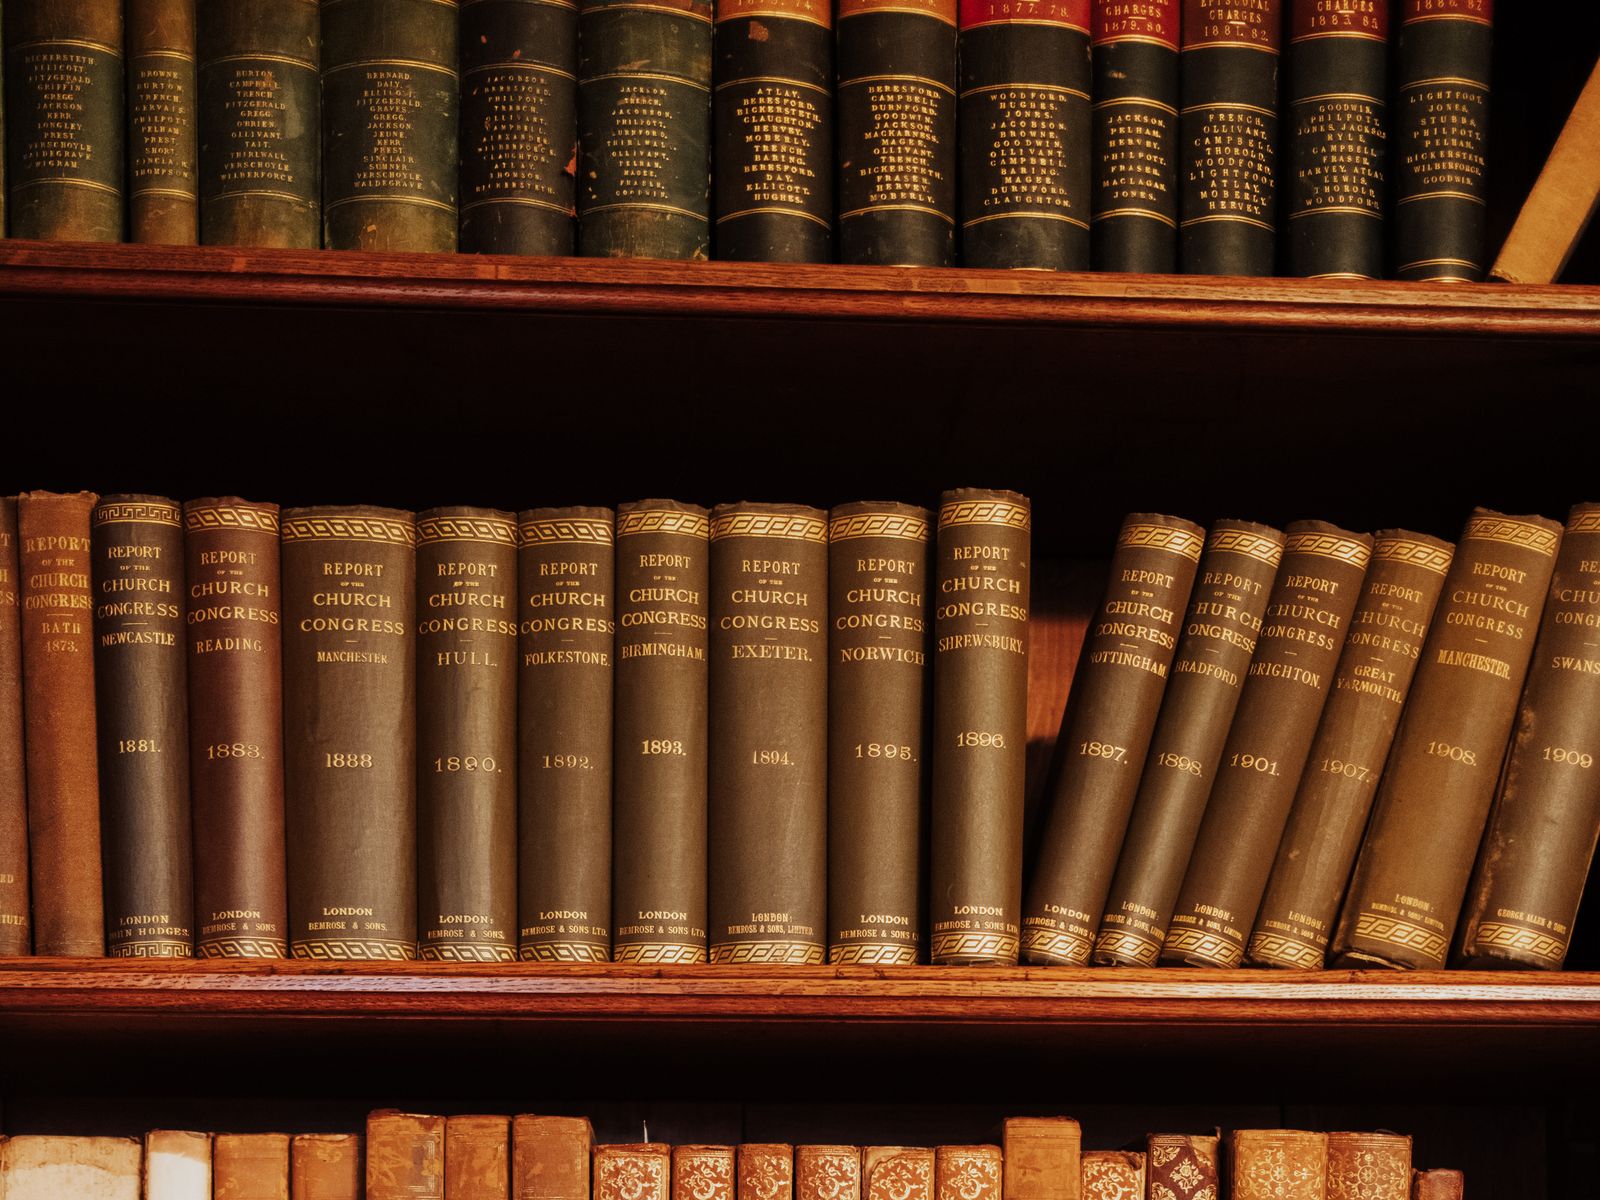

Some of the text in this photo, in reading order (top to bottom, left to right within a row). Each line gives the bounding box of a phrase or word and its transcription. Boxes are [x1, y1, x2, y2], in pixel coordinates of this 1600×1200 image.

[989, 3, 1038, 15] 1877.
[1105, 5, 1162, 17] CHARGES
[1317, 0, 1374, 13] CHARGES
[1209, 10, 1262, 23] CHARGES
[757, 88, 800, 99] ATLAY.
[868, 86, 941, 99] BERESFORD.
[990, 92, 1067, 102] WOODFORD.
[1411, 91, 1482, 104] LIGHTFOOT.
[743, 98, 815, 110] BERESFORD.
[871, 95, 937, 108] CAMPBELL.
[1000, 102, 1058, 110] HUGHES.
[737, 106, 821, 122] BICKERSTETH.
[871, 105, 937, 116] DURNFORD.
[1005, 110, 1052, 119] JONES.
[743, 115, 814, 129] CLAUGHTON.
[874, 113, 933, 124] GOODWIN.
[990, 121, 1066, 130] JACOBSON.
[1108, 115, 1166, 128] JACKSON.
[754, 125, 803, 136] HERVEY.
[864, 130, 939, 144] MACKARNESS.
[1000, 131, 1058, 139] BROWNE.
[746, 135, 810, 147] MOBERLY.
[994, 140, 1062, 149] GOODWIN.
[1426, 139, 1474, 150] PELHAM.
[754, 145, 806, 156] TRENCH.
[873, 147, 934, 158] OLLIVANT.
[1206, 147, 1266, 162] THOROLD.
[1312, 145, 1376, 158] CAMPBELL.
[755, 155, 806, 165] BARING.
[1104, 152, 1166, 166] PHILPOTT.
[1196, 158, 1272, 175] WOODFORD.
[860, 166, 943, 180] BICKERSTETH.
[746, 183, 810, 194] ELLICOTT.
[1103, 178, 1166, 192] MACLAGAN.
[1324, 176, 1367, 186] LEWIS.
[992, 186, 1068, 195] DURNFORD.
[1113, 190, 1156, 200] JONES.
[754, 194, 804, 204] HUGHES.
[984, 197, 1071, 208] CLAUGHTON.
[26, 536, 90, 553] REPORT
[108, 546, 162, 559] REPORT
[201, 550, 256, 566] REPORT
[954, 546, 1010, 560] REPORT
[640, 554, 690, 568] REPORT
[742, 560, 800, 574] REPORT
[857, 558, 914, 574] REPORT
[324, 562, 384, 577] REPORT
[438, 564, 498, 578] REPORT
[540, 562, 598, 576] REPORT
[1473, 562, 1526, 584] REPORT
[30, 573, 88, 588] CHURCH
[103, 578, 170, 593] CHURCH
[942, 576, 1020, 594] CHURCH
[1122, 569, 1174, 588] REPORT
[1204, 572, 1262, 596] REPORT
[1286, 576, 1338, 594] REPORT
[192, 582, 268, 598] CHURCH
[630, 588, 698, 604] CHURCH
[847, 589, 920, 606] CHURCH
[1370, 582, 1423, 604] REPORT
[313, 593, 392, 608] CHURCH
[429, 593, 504, 608] CHURCH
[530, 592, 606, 608] CHURCH
[732, 590, 808, 606] CHURCH
[1452, 591, 1530, 618] CHURCH
[98, 602, 178, 620] CONGRESS
[188, 606, 278, 624] CONGRESS
[936, 602, 1026, 622] CONGRESS
[1106, 600, 1174, 624] CHURCH
[42, 622, 80, 634] BATH
[301, 618, 404, 636] CONGRESS
[419, 618, 517, 636] CONGRESS
[521, 618, 615, 634] CONGRESS
[622, 611, 706, 630] CONGRESS
[720, 616, 819, 633] CONGRESS
[1446, 612, 1523, 640] CONGRESS
[46, 640, 78, 652] 1873.
[102, 632, 176, 647] NEWCASTLE
[197, 638, 266, 654] READING.
[939, 634, 1024, 655] SHREWSBURY.
[317, 651, 389, 664] MANCHESTER
[438, 652, 498, 666] HULL.
[525, 651, 610, 667] FOLKESTONE.
[622, 643, 706, 662] BIRMINGHAM.
[732, 645, 812, 662] EXETER.
[841, 646, 924, 666] NORWICH
[1091, 651, 1168, 679] NOTTINGHAM.
[1437, 650, 1510, 680] MANCHESTER.
[1176, 660, 1238, 688] BRADFORD.
[1250, 662, 1320, 690] BRIGHTON.
[1354, 665, 1396, 684] GREAT
[1337, 678, 1402, 704] YARMOUTH.
[118, 740, 161, 754] 1881.
[642, 740, 686, 756] 1893.
[956, 732, 1006, 749] 1896.
[206, 744, 265, 760] 1883.
[753, 750, 795, 766] 1894.
[855, 744, 917, 762] 1895.
[1080, 742, 1128, 764] 1897.
[1427, 742, 1478, 766] 1908.
[1542, 746, 1593, 768] 1909
[326, 753, 372, 769] 1888
[434, 756, 502, 773] 1890.
[542, 754, 594, 770] 1892.
[1158, 752, 1202, 778] 1898.
[1230, 753, 1280, 776] 1901.
[1320, 758, 1371, 784] 1907.
[212, 910, 260, 920] LONDON
[323, 908, 372, 916] LONDON
[540, 911, 588, 921] LONDON
[638, 912, 686, 920] LONDON
[954, 906, 1002, 916] LONDON
[1044, 904, 1090, 922] LONDON
[120, 914, 168, 926] LONDON
[860, 914, 908, 925] LONDON
[256, 924, 276, 932] SONS
